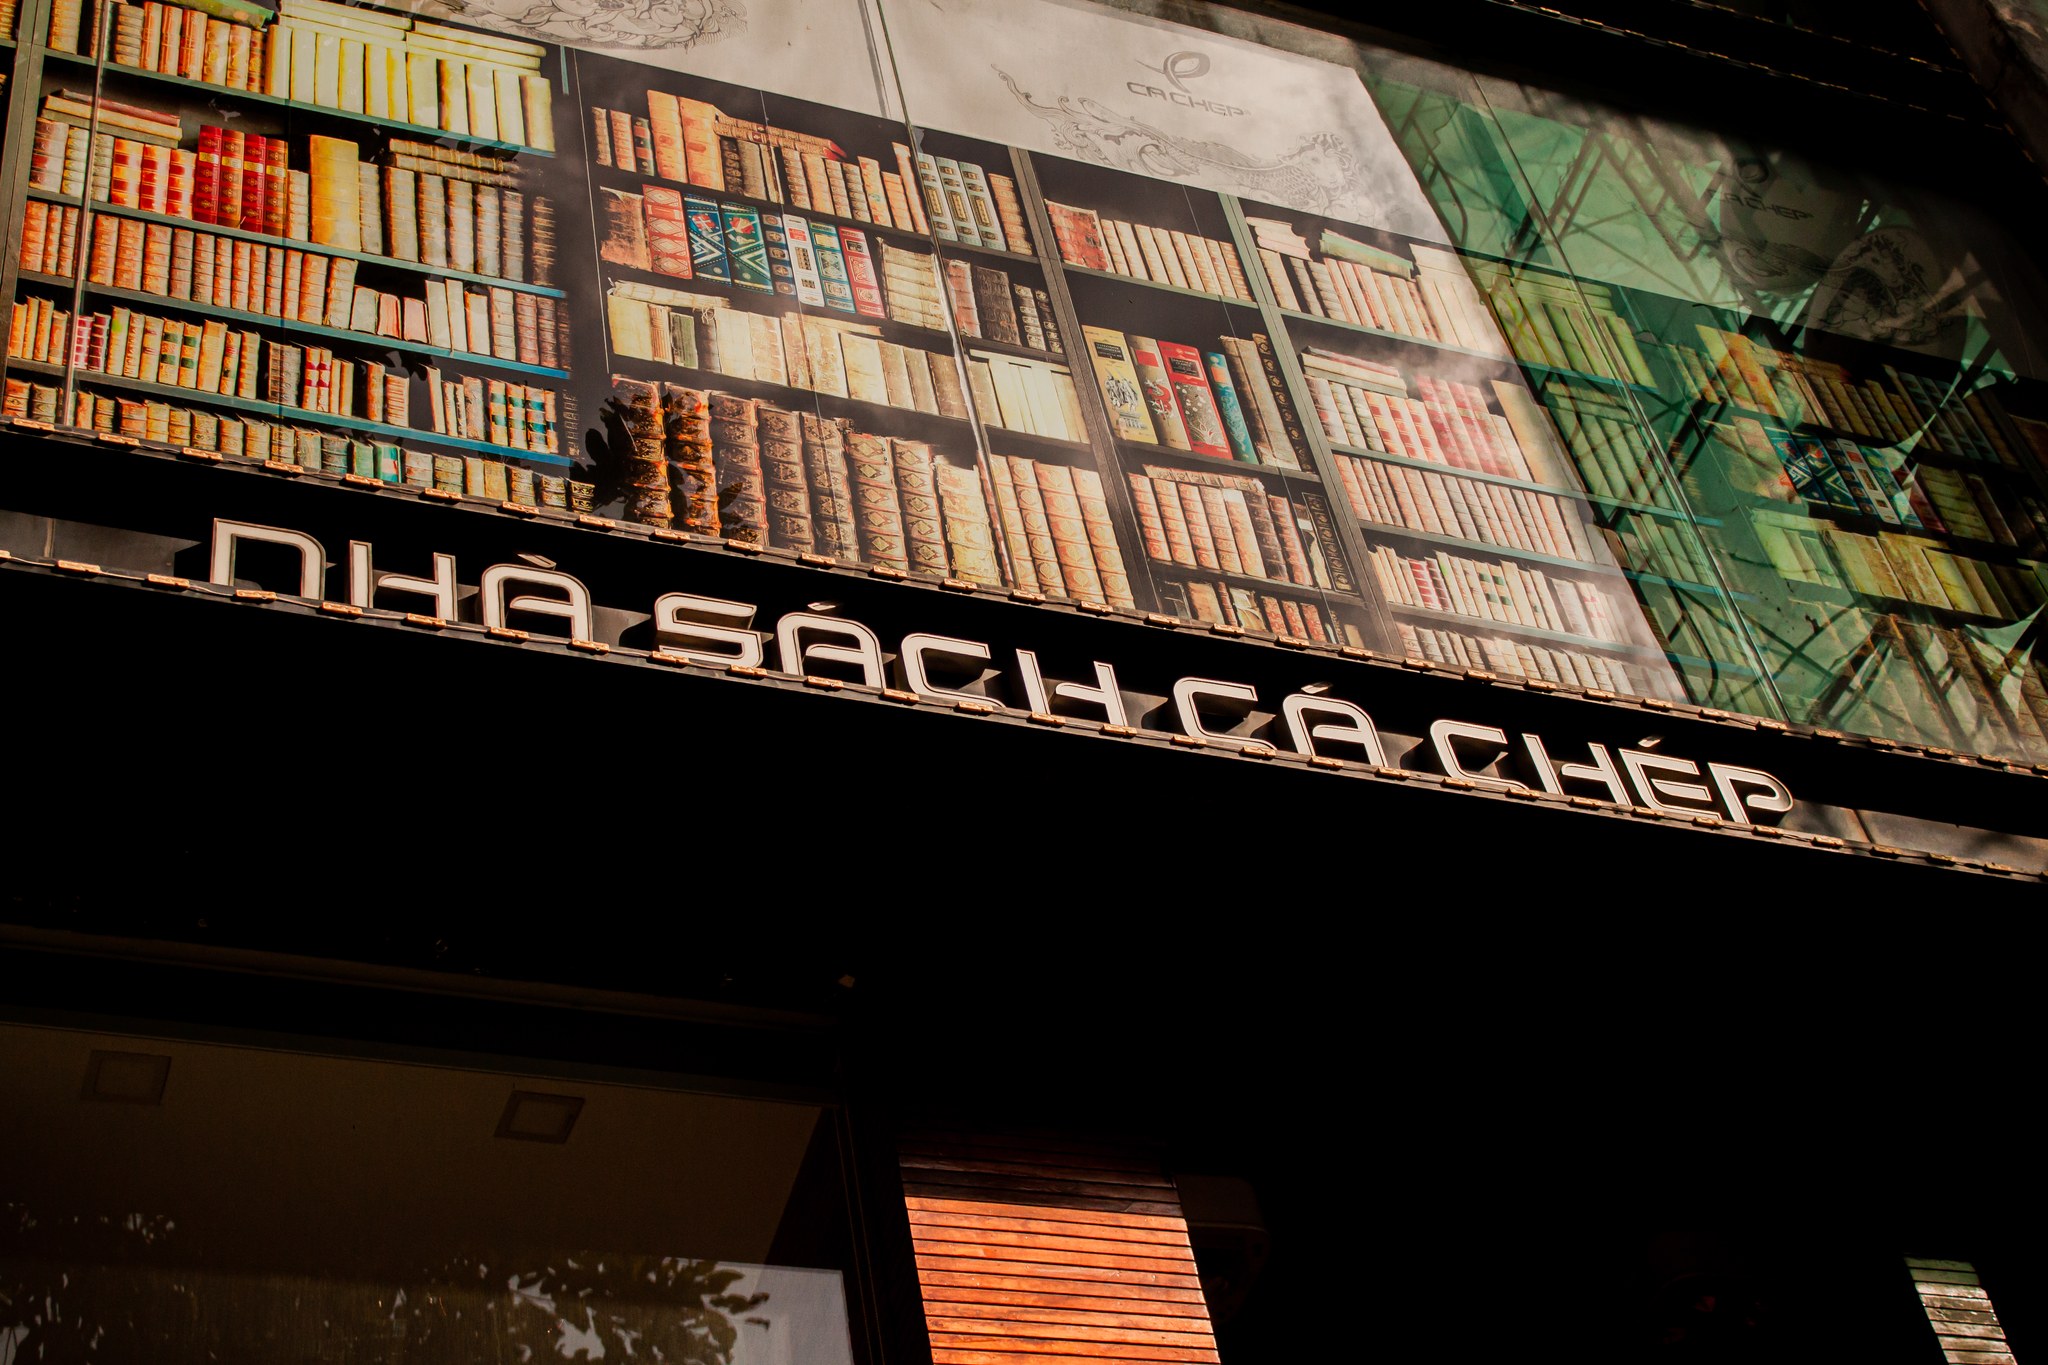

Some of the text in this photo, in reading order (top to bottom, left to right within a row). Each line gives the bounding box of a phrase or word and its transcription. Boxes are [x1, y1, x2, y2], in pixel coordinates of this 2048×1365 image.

[210, 517, 1793, 825] NHÀ SÁCH CÁ CHÉP
